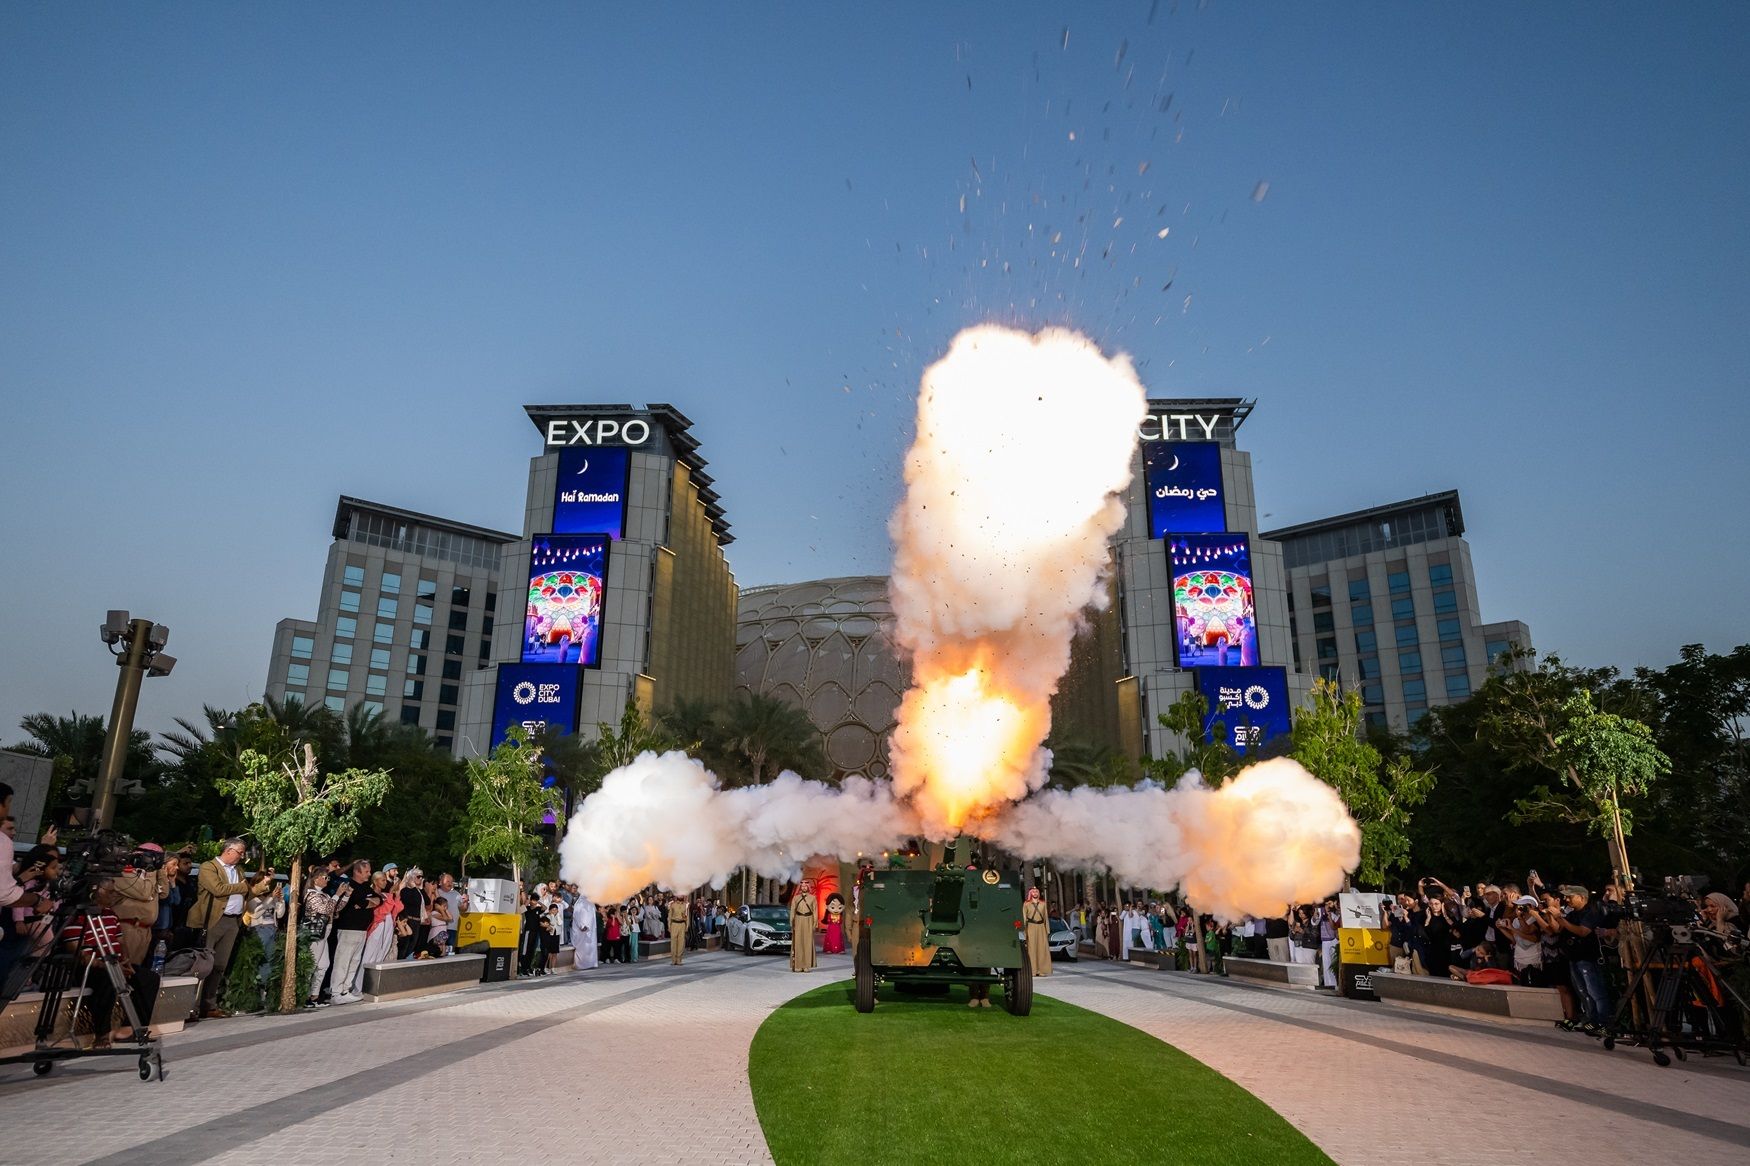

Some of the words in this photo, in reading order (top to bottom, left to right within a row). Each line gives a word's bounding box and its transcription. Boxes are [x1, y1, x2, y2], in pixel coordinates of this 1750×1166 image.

[547, 420, 650, 445] EXPO
[1138, 414, 1220, 440] CITY
[578, 491, 619, 502] Ramadan
[1155, 485, 1194, 499] رمضان
[539, 683, 560, 691] EXPO
[1219, 686, 1242, 695] مدينة
